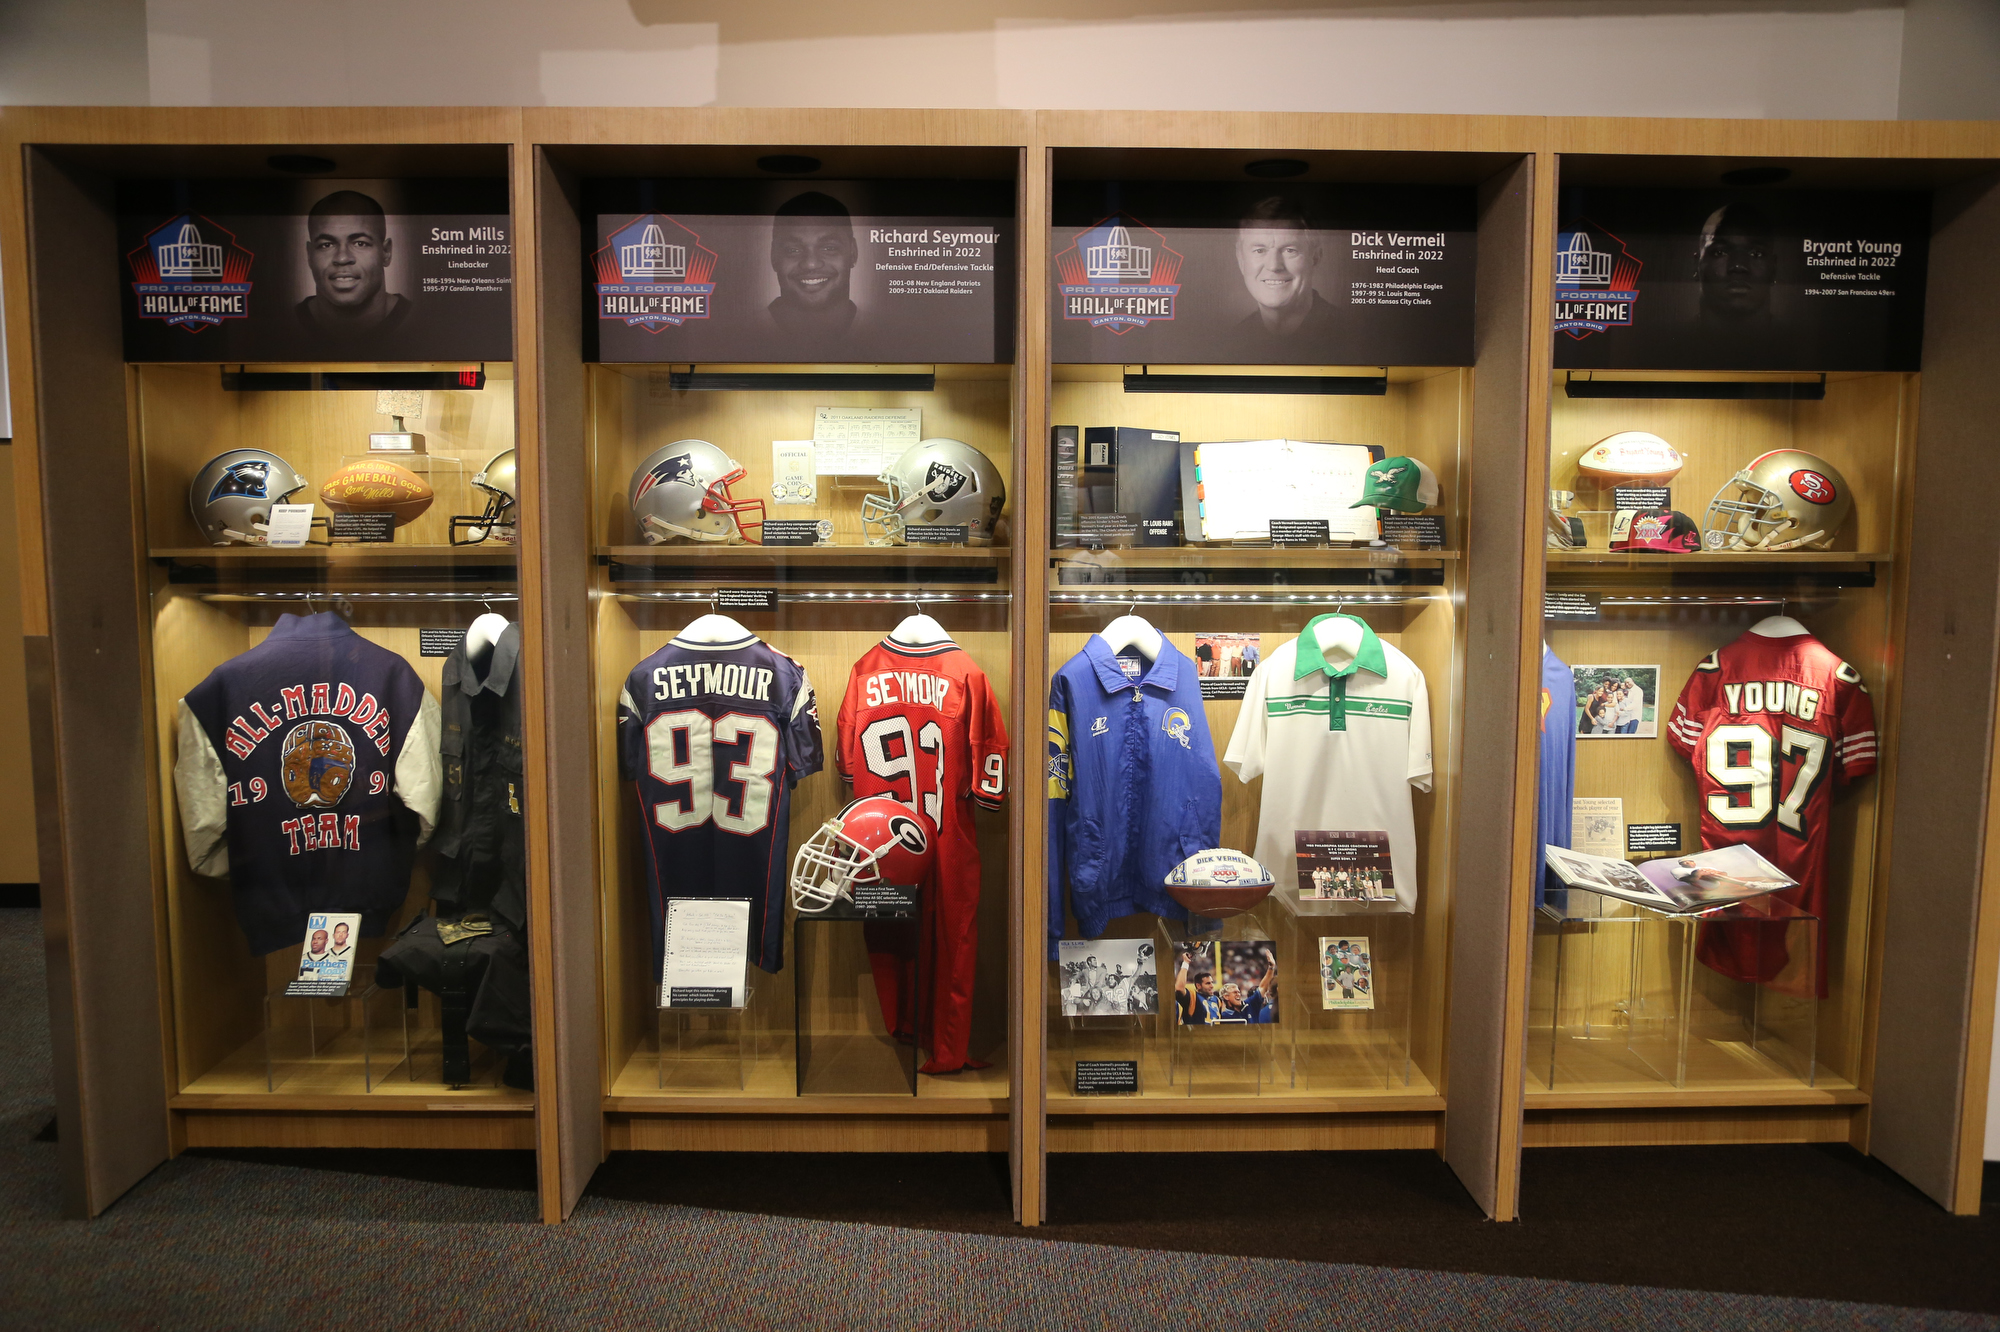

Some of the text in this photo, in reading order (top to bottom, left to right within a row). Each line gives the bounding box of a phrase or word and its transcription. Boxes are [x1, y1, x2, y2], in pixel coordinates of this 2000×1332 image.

[431, 227, 505, 241] Sam Mills
[870, 229, 1001, 247] Richard Seymour
[1351, 232, 1445, 247] Dick Vermeil
[422, 245, 473, 255] Enshrined
[475, 245, 485, 255] in
[888, 247, 981, 257] Enshrined in 2022
[1803, 239, 1902, 257] Bryant Young
[1352, 250, 1444, 260] Enshrined in 2022
[448, 261, 489, 269] Linebacker
[875, 263, 994, 271] Defensive End/Defensive Tackle
[1806, 256, 1896, 267] Enshrined in 2022
[1376, 266, 1420, 274] Head Coach
[1820, 272, 1881, 281] Defensive Tackle
[930, 280, 956, 288] England
[1385, 283, 1422, 291] Philadelphia
[1423, 283, 1443, 291] Eagles
[1561, 292, 1632, 300] FOOTBALL
[144, 296, 243, 313] HALL OF FAME
[605, 296, 705, 313] HALL OF FAME
[1069, 297, 1169, 315] HALL OF FAME
[1574, 304, 1585, 314] OF
[1585, 303, 1628, 320] FAME
[201, 315, 219, 323] OHIO
[662, 316, 680, 324] OHIO
[1126, 317, 1145, 325] OHIO
[1586, 322, 1603, 330] OHIO
[1644, 448, 1665, 459] Young
[375, 463, 396, 473] 1983
[934, 463, 964, 481] RAIDERS
[323, 473, 422, 493] STARS GAME BALL GOLD
[342, 485, 413, 500] Sam Mills 7
[1637, 529, 1661, 538] XXIX
[653, 663, 773, 701] SEYMOUR
[1724, 681, 1820, 722] YOUNG
[1366, 703, 1389, 715] Eagles
[644, 708, 780, 837] 93
[860, 715, 945, 836] 93
[981, 753, 1005, 795] 9
[228, 770, 390, 806] 19 9
[1706, 724, 1833, 841] 97
[281, 813, 360, 856] TEAM
[1196, 856, 1248, 865] DICK VERMEIL
[1171, 862, 1188, 885] 23
[1259, 863, 1271, 884] 16
[311, 916, 326, 925] TV
[303, 959, 348, 969] Panthers
